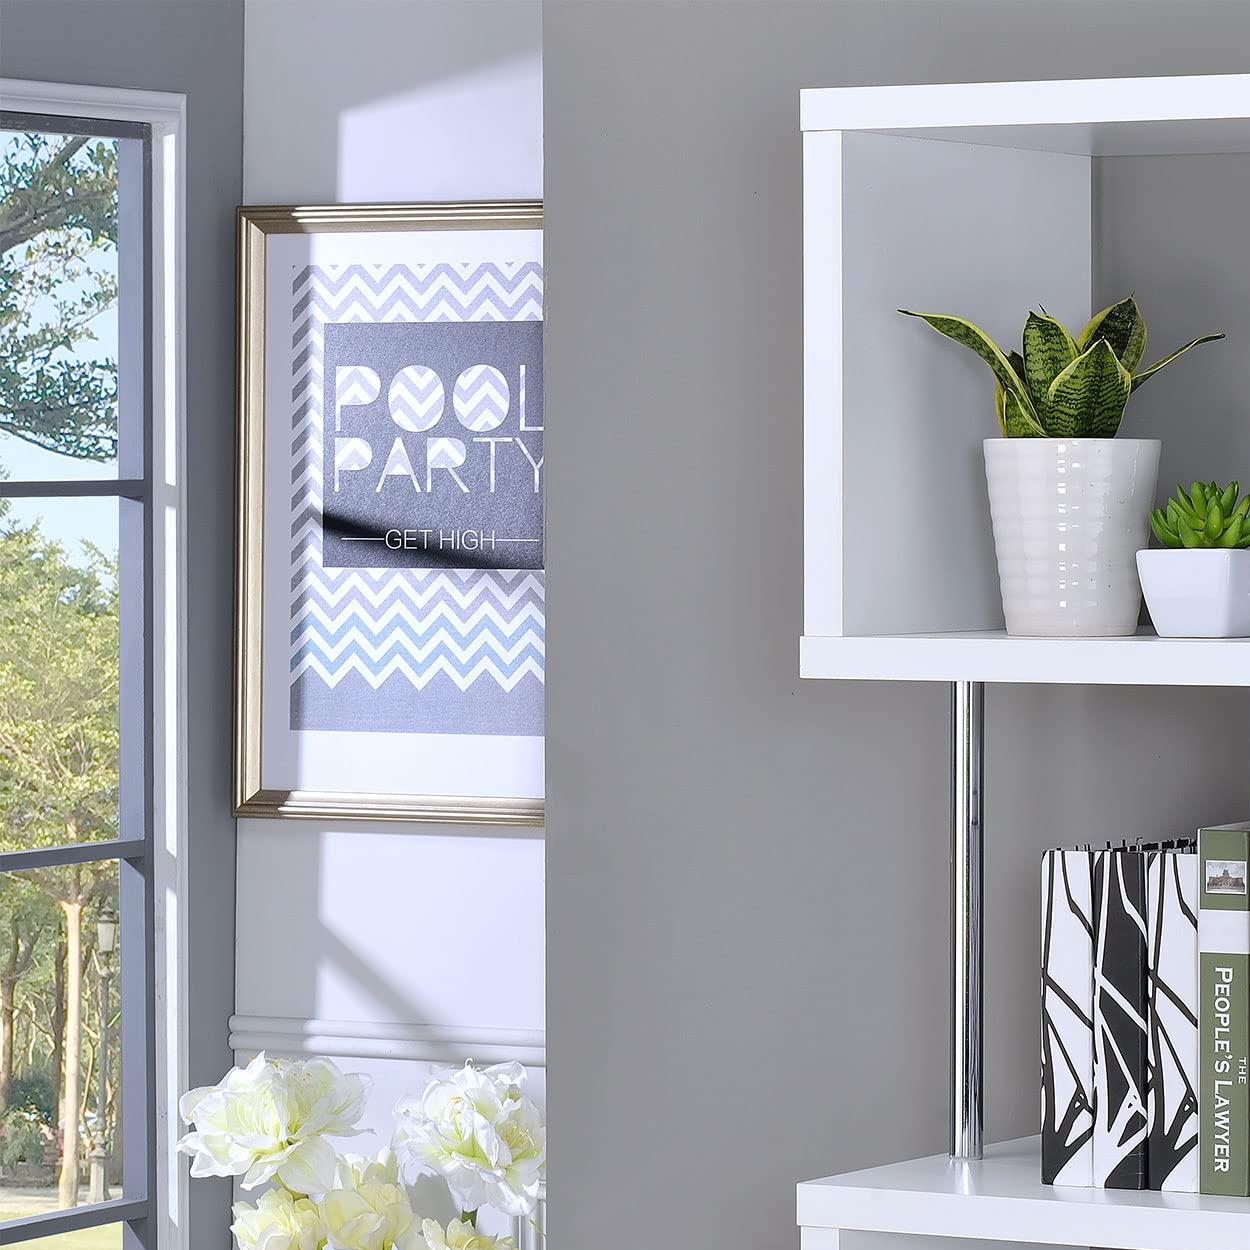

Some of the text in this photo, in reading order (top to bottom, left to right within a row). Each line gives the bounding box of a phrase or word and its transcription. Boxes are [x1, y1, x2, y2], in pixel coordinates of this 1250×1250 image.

[335, 364, 544, 433] POOL
[334, 437, 544, 493] PARTY
[385, 529, 495, 550] GET HIGH
[1214, 966, 1233, 1173] PEOPLE'S LAWYER
[1238, 1056, 1247, 1084] THE
